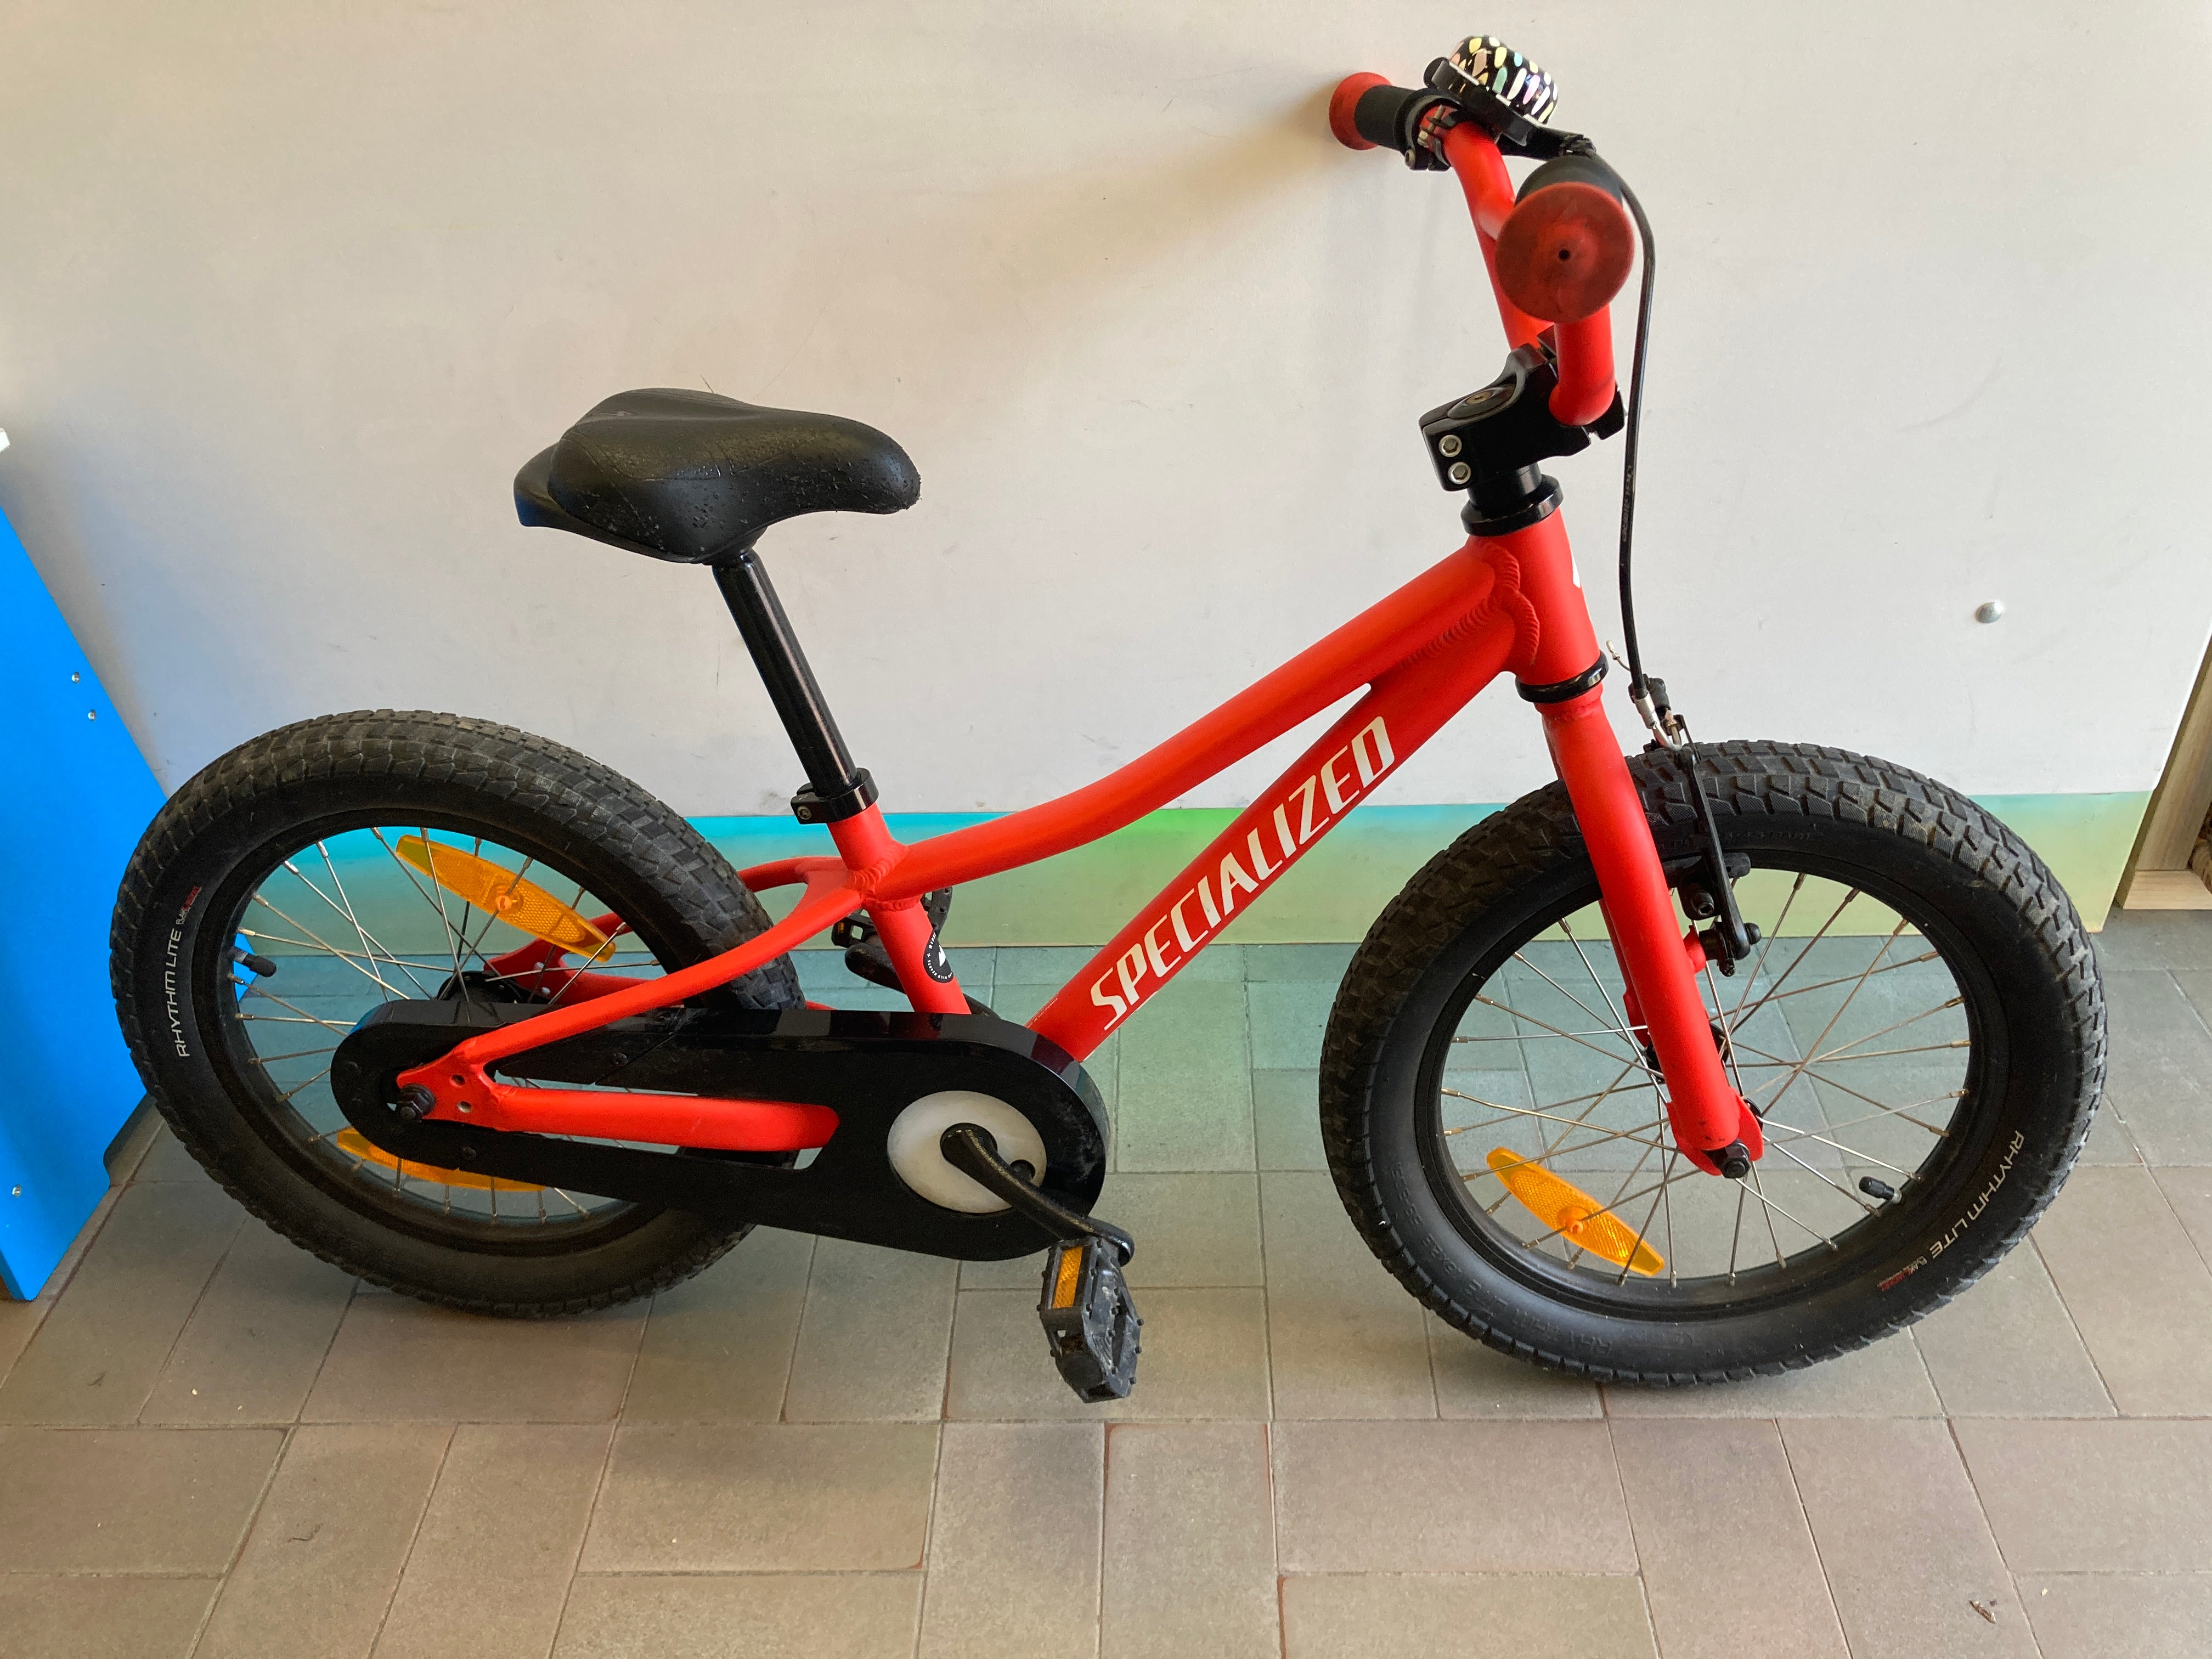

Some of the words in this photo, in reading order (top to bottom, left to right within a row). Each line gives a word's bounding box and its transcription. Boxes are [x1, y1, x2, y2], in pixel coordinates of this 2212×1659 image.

[1090, 715, 1395, 1031] SPECIALIZED
[165, 928, 182, 968] LITE
[165, 970, 190, 1057] RHYTHM
[1967, 1130, 2025, 1221] RHYTHM
[1929, 1217, 1968, 1260] LITE
